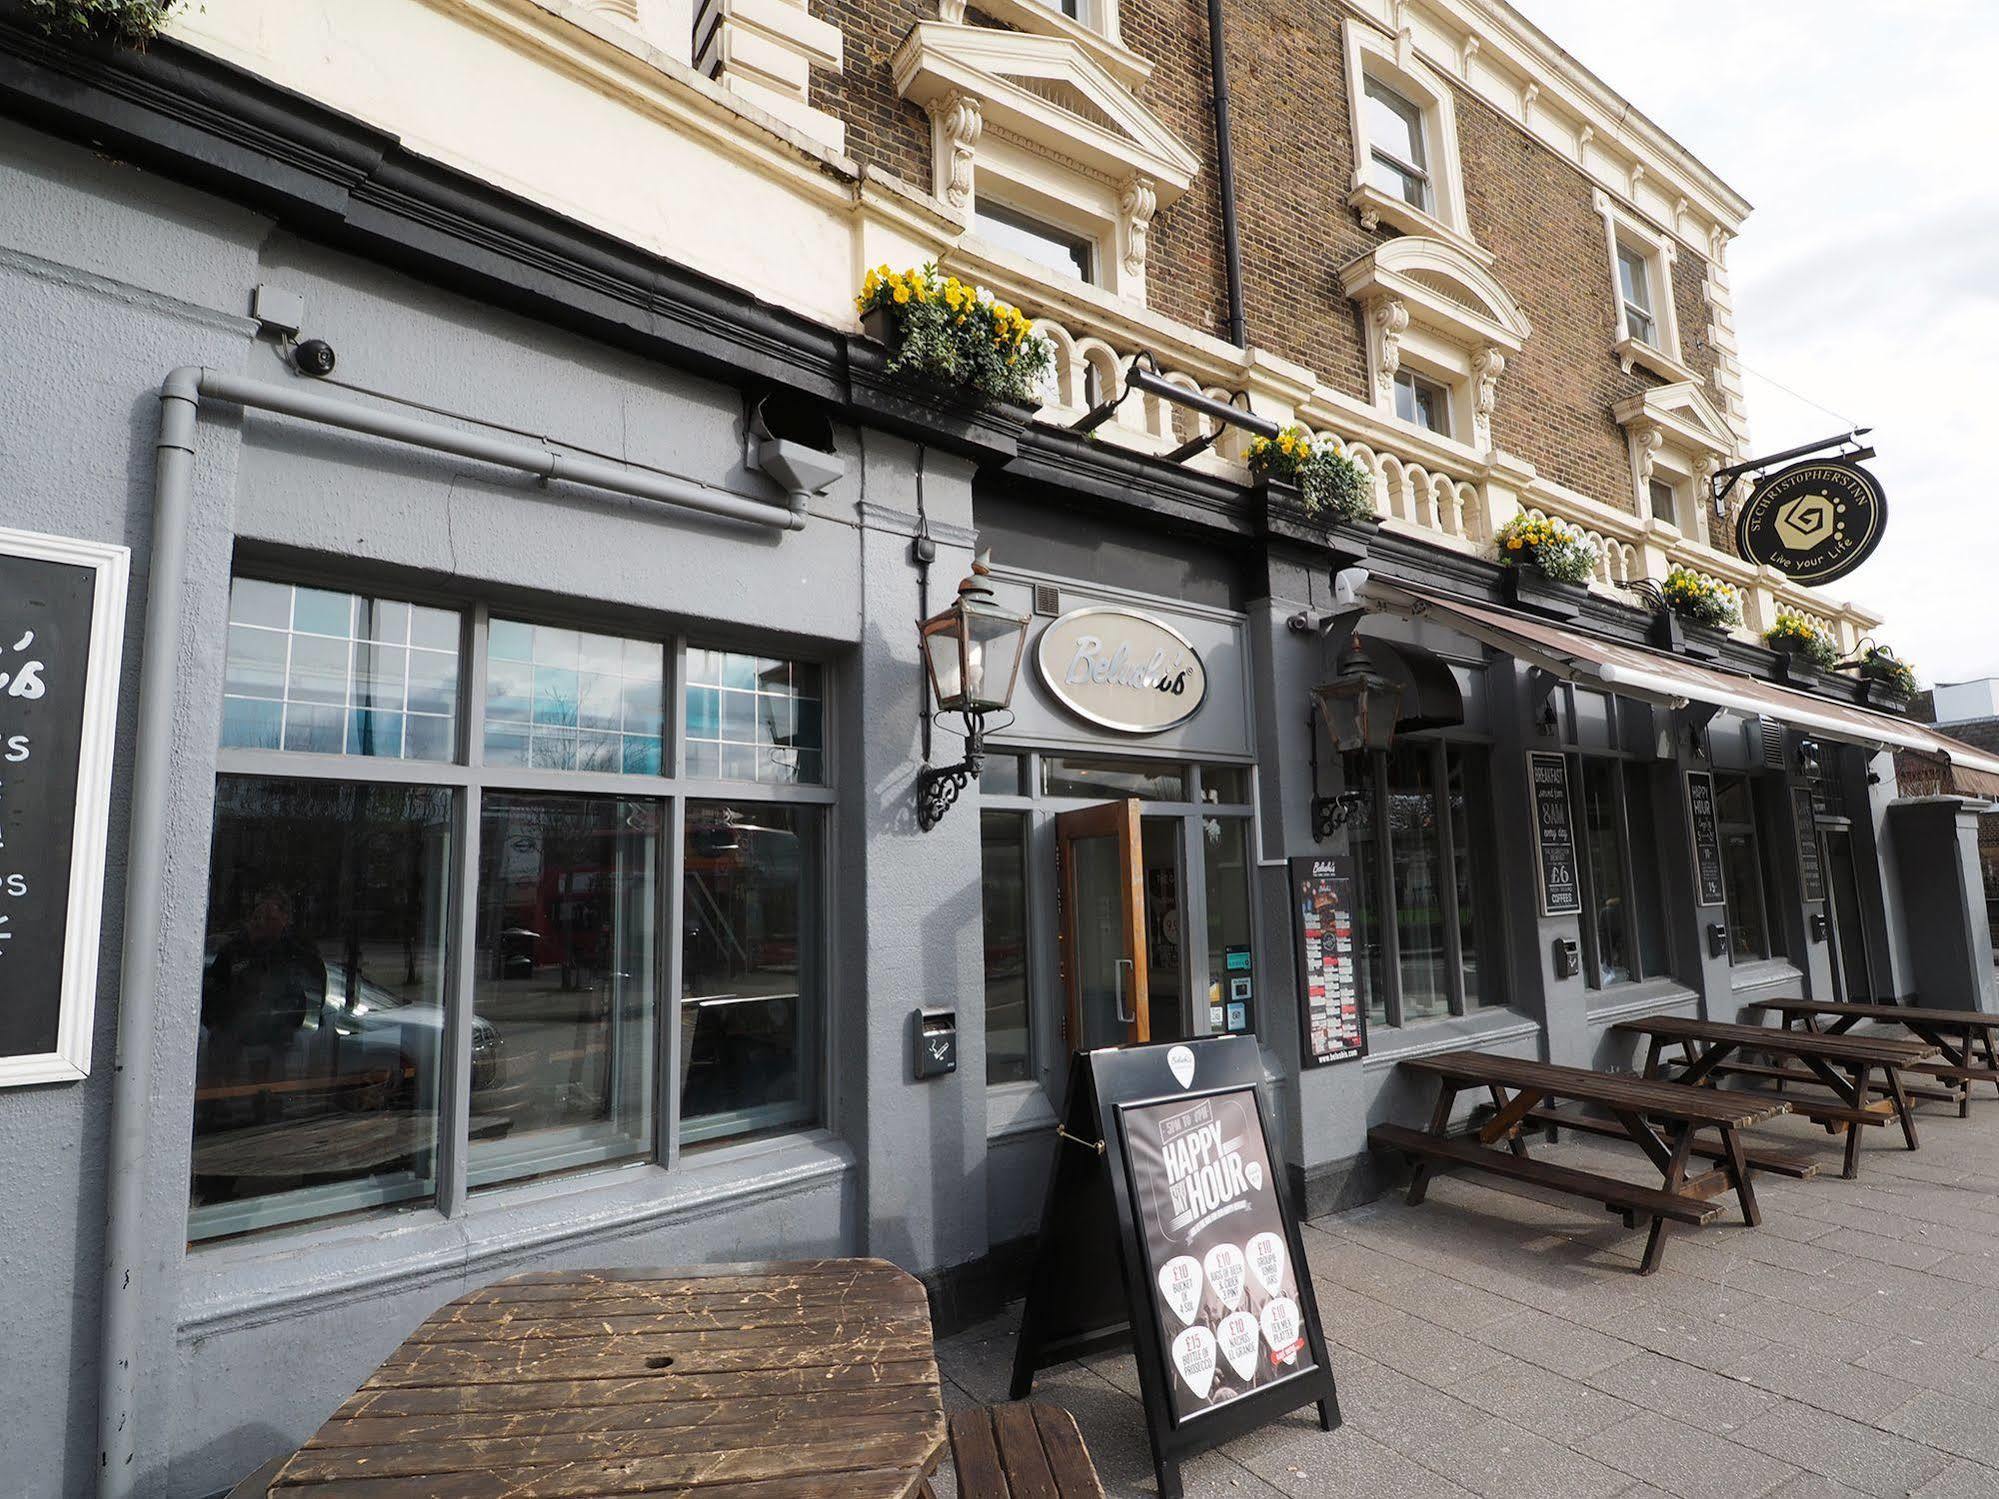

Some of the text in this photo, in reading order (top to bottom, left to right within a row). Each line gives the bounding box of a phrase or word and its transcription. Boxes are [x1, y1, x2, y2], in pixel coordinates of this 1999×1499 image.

[1755, 470, 1850, 516] CHRISTOPHER'S
[1847, 481, 1868, 506] INN
[1770, 539, 1853, 570] Live your Life
[1534, 767, 1563, 784] BREAKFAST
[1551, 865, 1569, 883] £6
[1552, 893, 1572, 903] COFFEES
[1162, 1120, 1224, 1185] HAPPY
[1185, 1152, 1249, 1221] HOUR
[1258, 1240, 1272, 1255] £10
[1216, 1251, 1230, 1268] £10
[1173, 1264, 1188, 1281] £10
[1271, 1304, 1285, 1321] £10
[1229, 1319, 1245, 1335] £10
[1185, 1334, 1201, 1351] £15
[1229, 1332, 1250, 1346] NACHOS
[1182, 1349, 1201, 1365] BOTTLE
[1236, 1341, 1256, 1358] GRANDE
[1184, 1358, 1213, 1376] PROSECCO
